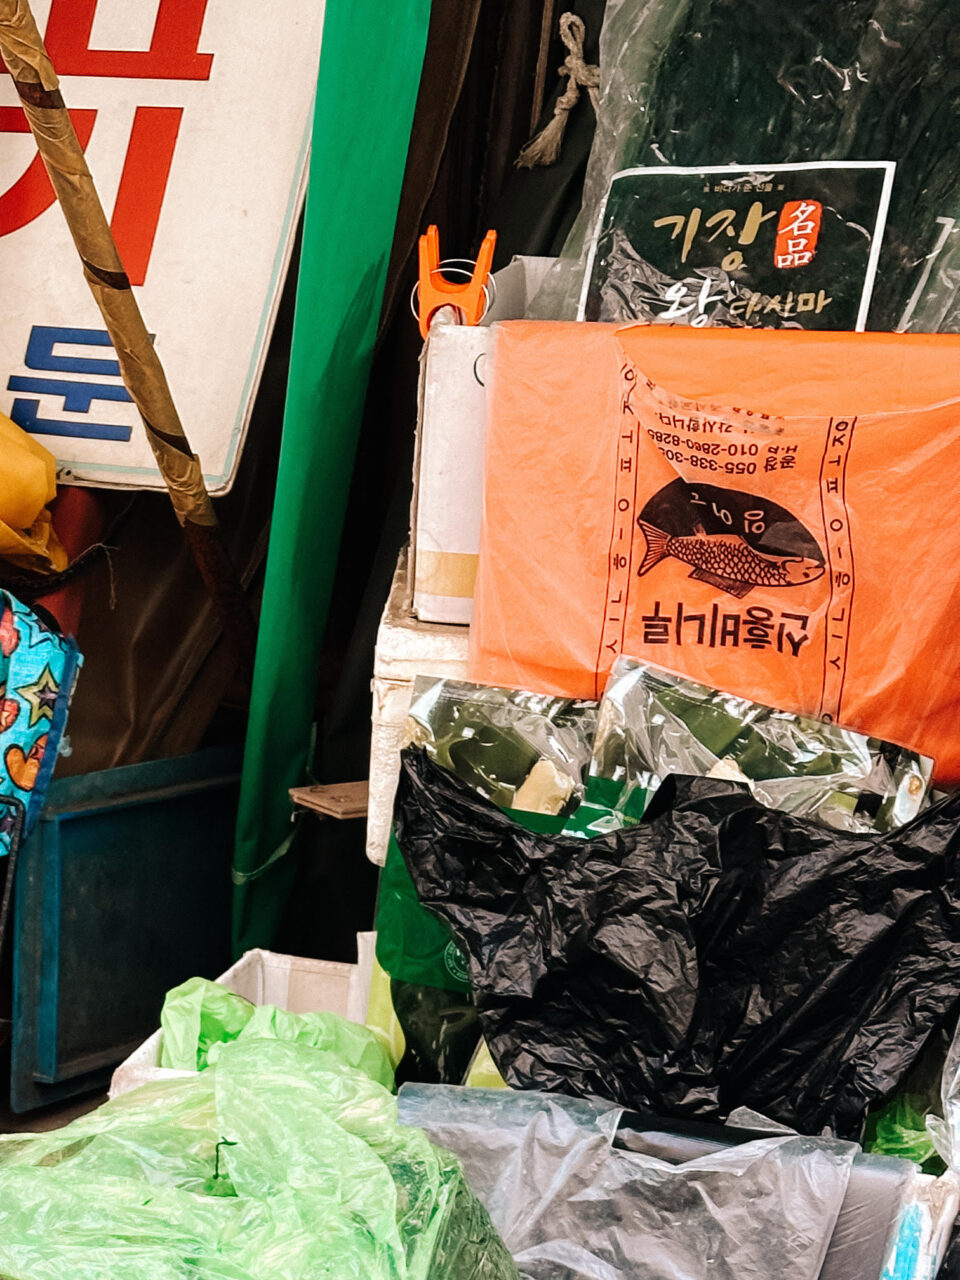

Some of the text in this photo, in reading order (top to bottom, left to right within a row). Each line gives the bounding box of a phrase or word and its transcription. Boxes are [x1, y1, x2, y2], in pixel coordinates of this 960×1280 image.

[653, 201, 777, 272] 기장
[777, 202, 816, 269] 名品
[660, 277, 833, 328] 왕 다시마
[641, 600, 810, 658] 신흥비니루
